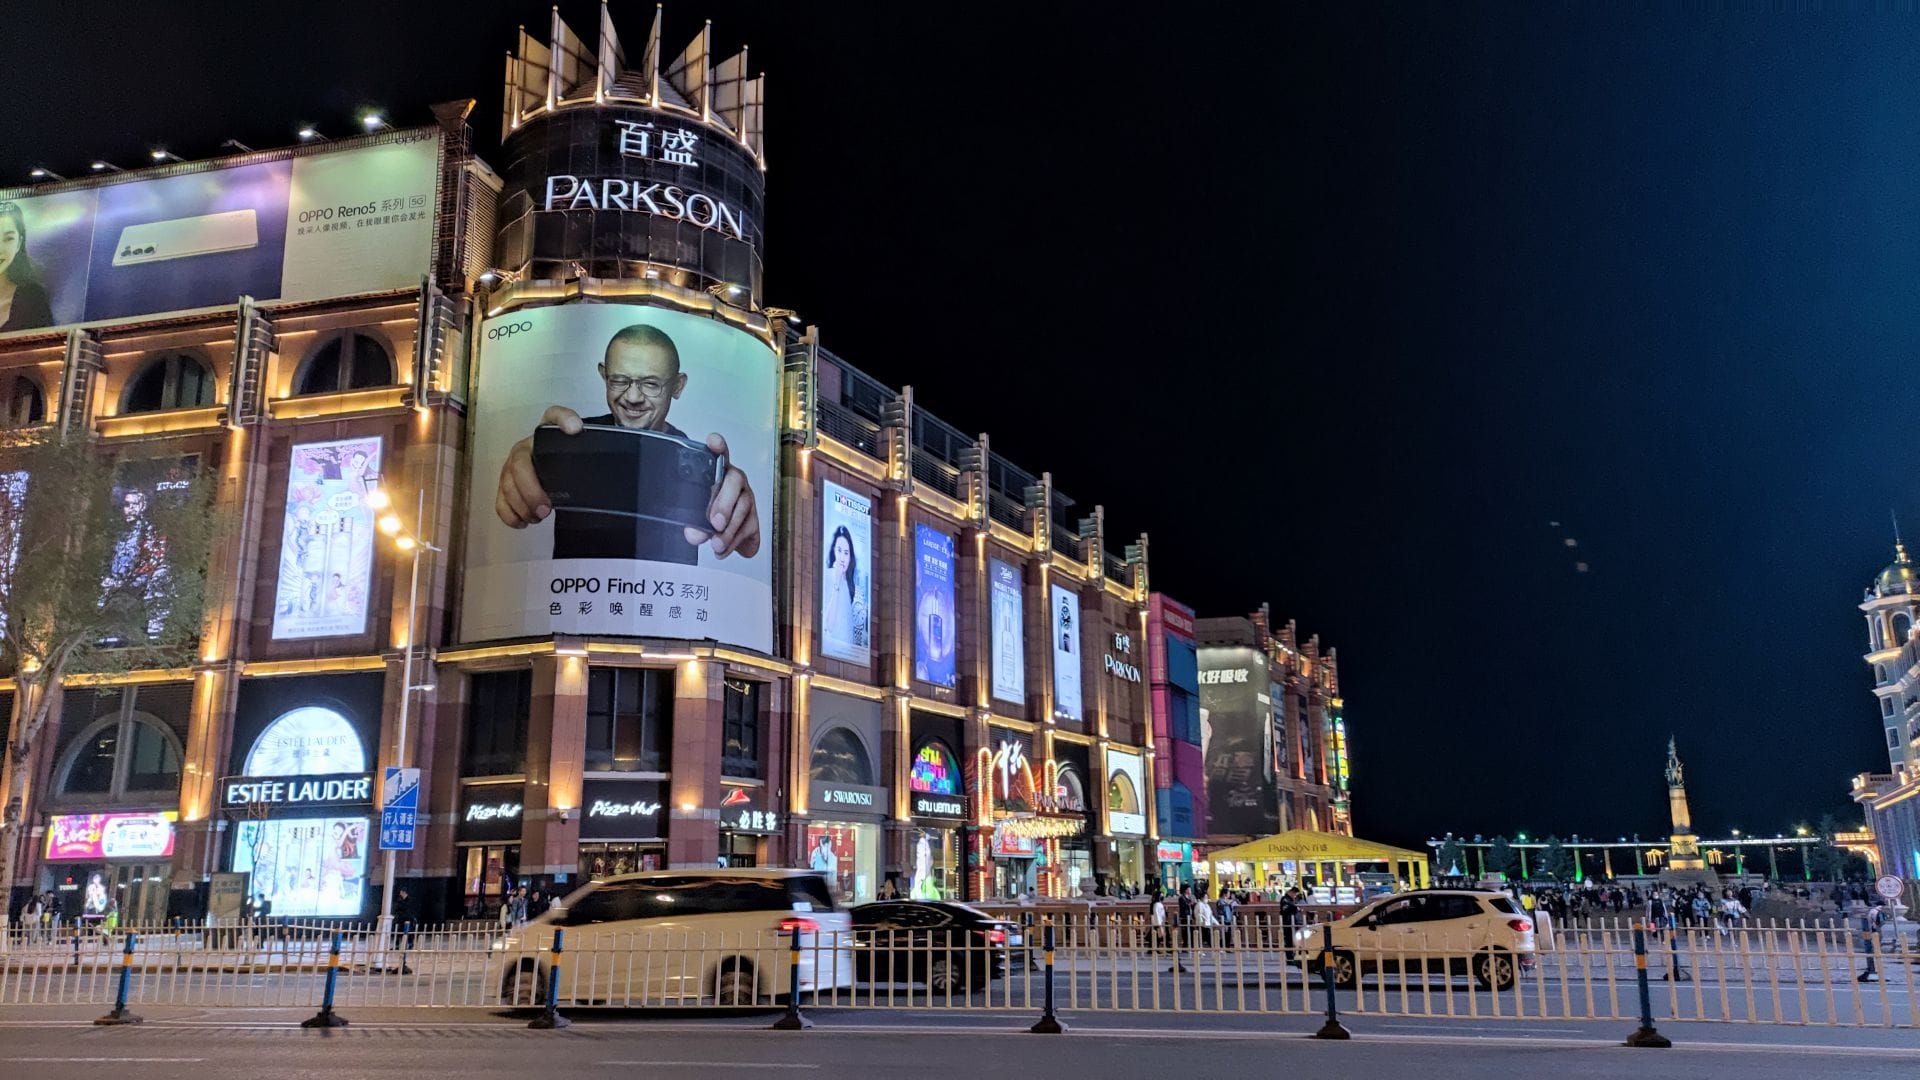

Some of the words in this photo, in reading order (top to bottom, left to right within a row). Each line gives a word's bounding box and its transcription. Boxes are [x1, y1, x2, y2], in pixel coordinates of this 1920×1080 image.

[614, 119, 700, 168] 百盛
[298, 207, 334, 224] OPPO
[338, 201, 377, 218] Reno5
[381, 197, 405, 213] 系列
[411, 196, 425, 207] 5G
[545, 174, 744, 240] PARKSON
[487, 320, 533, 341] oppo
[550, 577, 601, 595] OPPO
[607, 577, 646, 595] Find
[652, 580, 675, 598] X3
[680, 582, 710, 602] 系列
[548, 601, 709, 622] 色彩唤醒感动
[1114, 632, 1131, 655] 百盛
[1104, 653, 1142, 684] PARKSON
[288, 779, 369, 802] LAUDER
[833, 790, 873, 806] SWAROVSKI
[465, 804, 497, 822] Pizza
[496, 803, 523, 818] Hut
[589, 800, 629, 818] Pizza
[628, 801, 662, 817] Hut
[917, 799, 933, 813] shu
[933, 801, 961, 815] uemura
[738, 809, 778, 831] 必胜客
[1268, 843, 1310, 853] PARKSON
